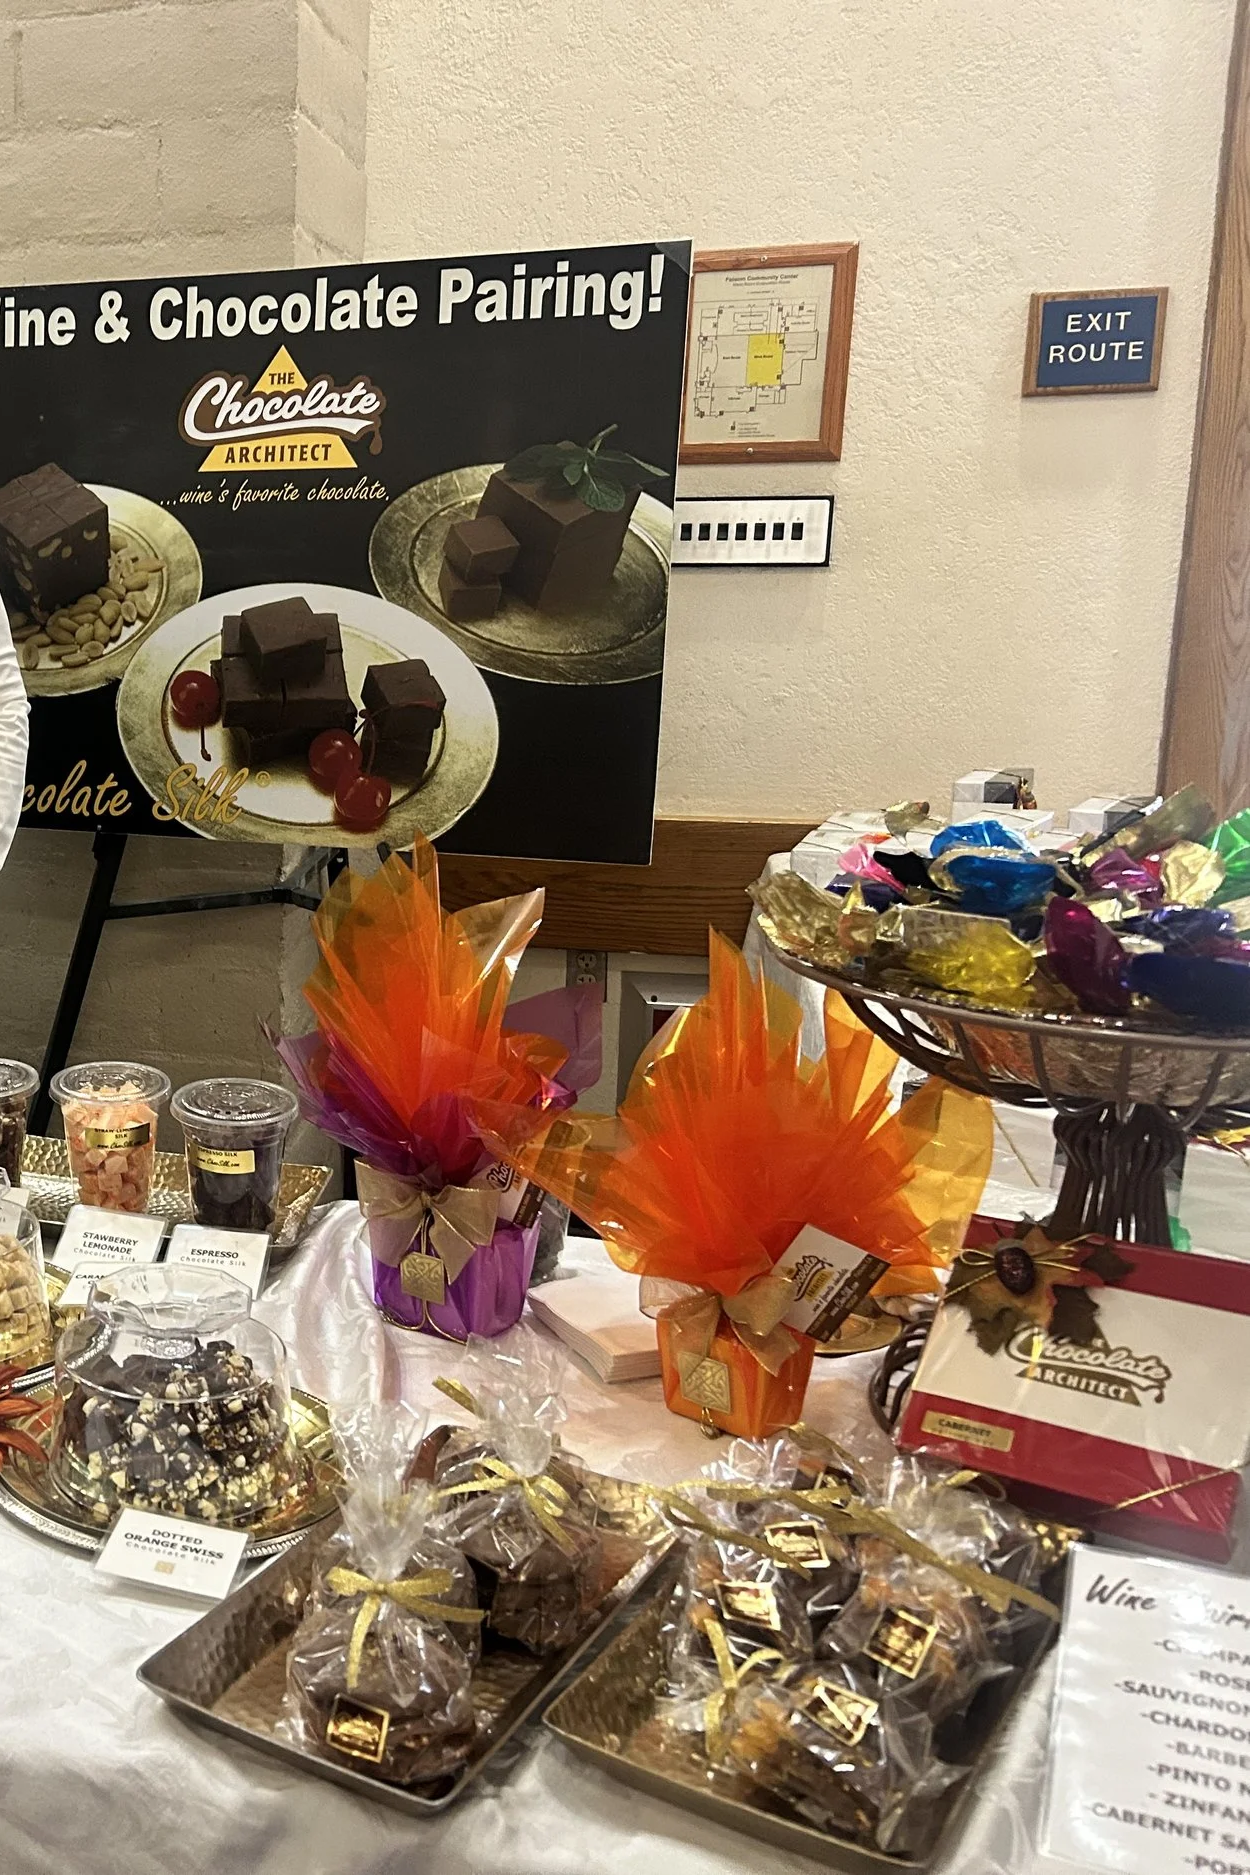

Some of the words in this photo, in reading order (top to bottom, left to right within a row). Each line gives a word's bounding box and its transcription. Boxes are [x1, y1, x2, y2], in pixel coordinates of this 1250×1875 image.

[94, 290, 131, 343] &
[150, 274, 417, 341] Chocolate
[438, 254, 665, 331] Pairing!
[1066, 311, 1132, 334] EXIT
[1048, 340, 1145, 365] ROUTE
[268, 371, 295, 385] THE
[183, 375, 381, 440] Chocolate
[224, 443, 332, 464] ARCHITECT
[233, 482, 301, 512] favorite
[306, 475, 390, 501] chocolate.
[82, 1231, 139, 1247] STAWBERRY
[82, 1240, 132, 1255] LEMONADE
[73, 1247, 116, 1261] Chocolate
[120, 1254, 136, 1262] Silk
[180, 1256, 225, 1266] Chocolate
[229, 1259, 247, 1267] Silk
[190, 1248, 239, 1259] ESPRESSO
[1007, 1324, 1169, 1380] Chocolate
[1030, 1366, 1129, 1401] ARCHITECT
[938, 1419, 992, 1437] CABERNET
[124, 1532, 179, 1550] ORANGE
[180, 1543, 224, 1560] SWISS
[151, 1529, 203, 1545] DOTTED
[126, 1542, 186, 1559] Chocolate
[193, 1555, 216, 1566] Silk
[1085, 1574, 1158, 1611] Wine
